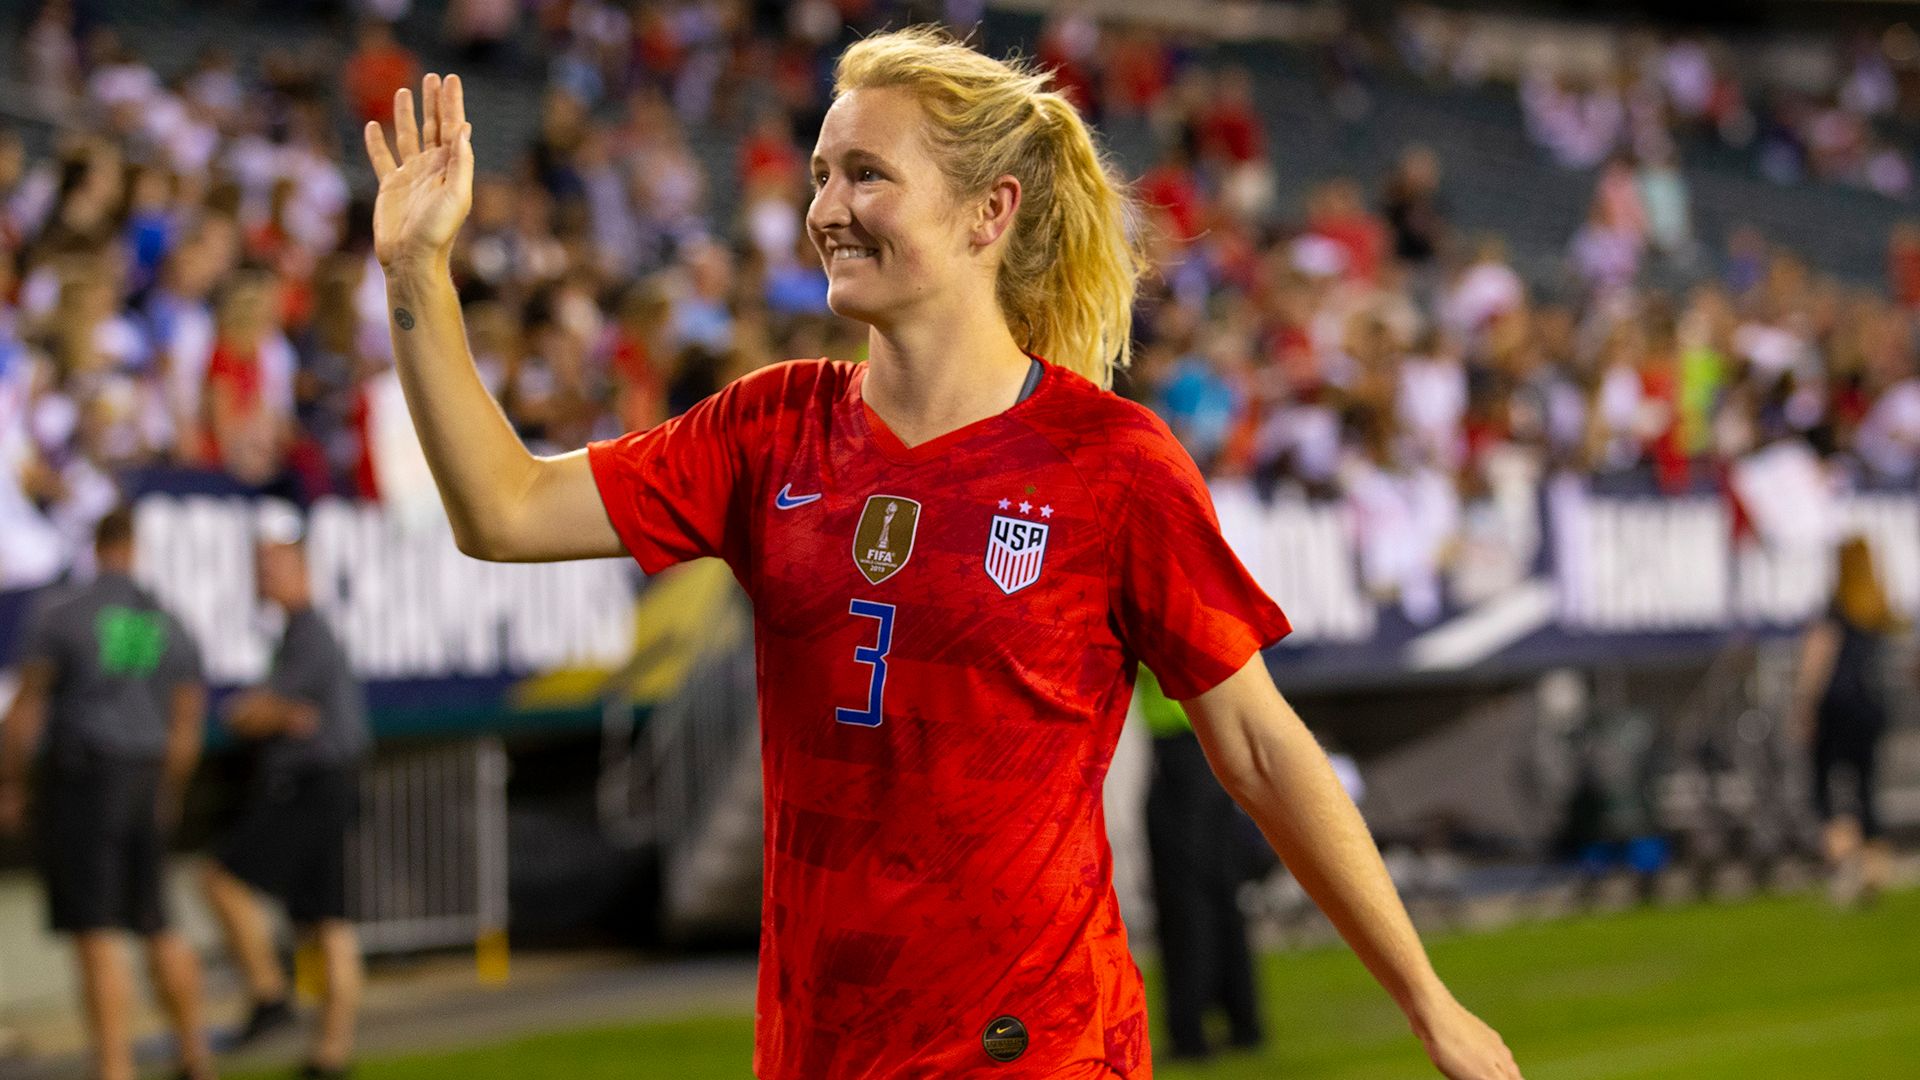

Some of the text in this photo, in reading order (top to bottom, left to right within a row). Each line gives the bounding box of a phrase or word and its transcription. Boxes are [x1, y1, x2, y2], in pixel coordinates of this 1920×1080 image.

[995, 520, 1043, 551] USA
[867, 549, 892, 562] FIFA
[836, 598, 896, 728] 3
